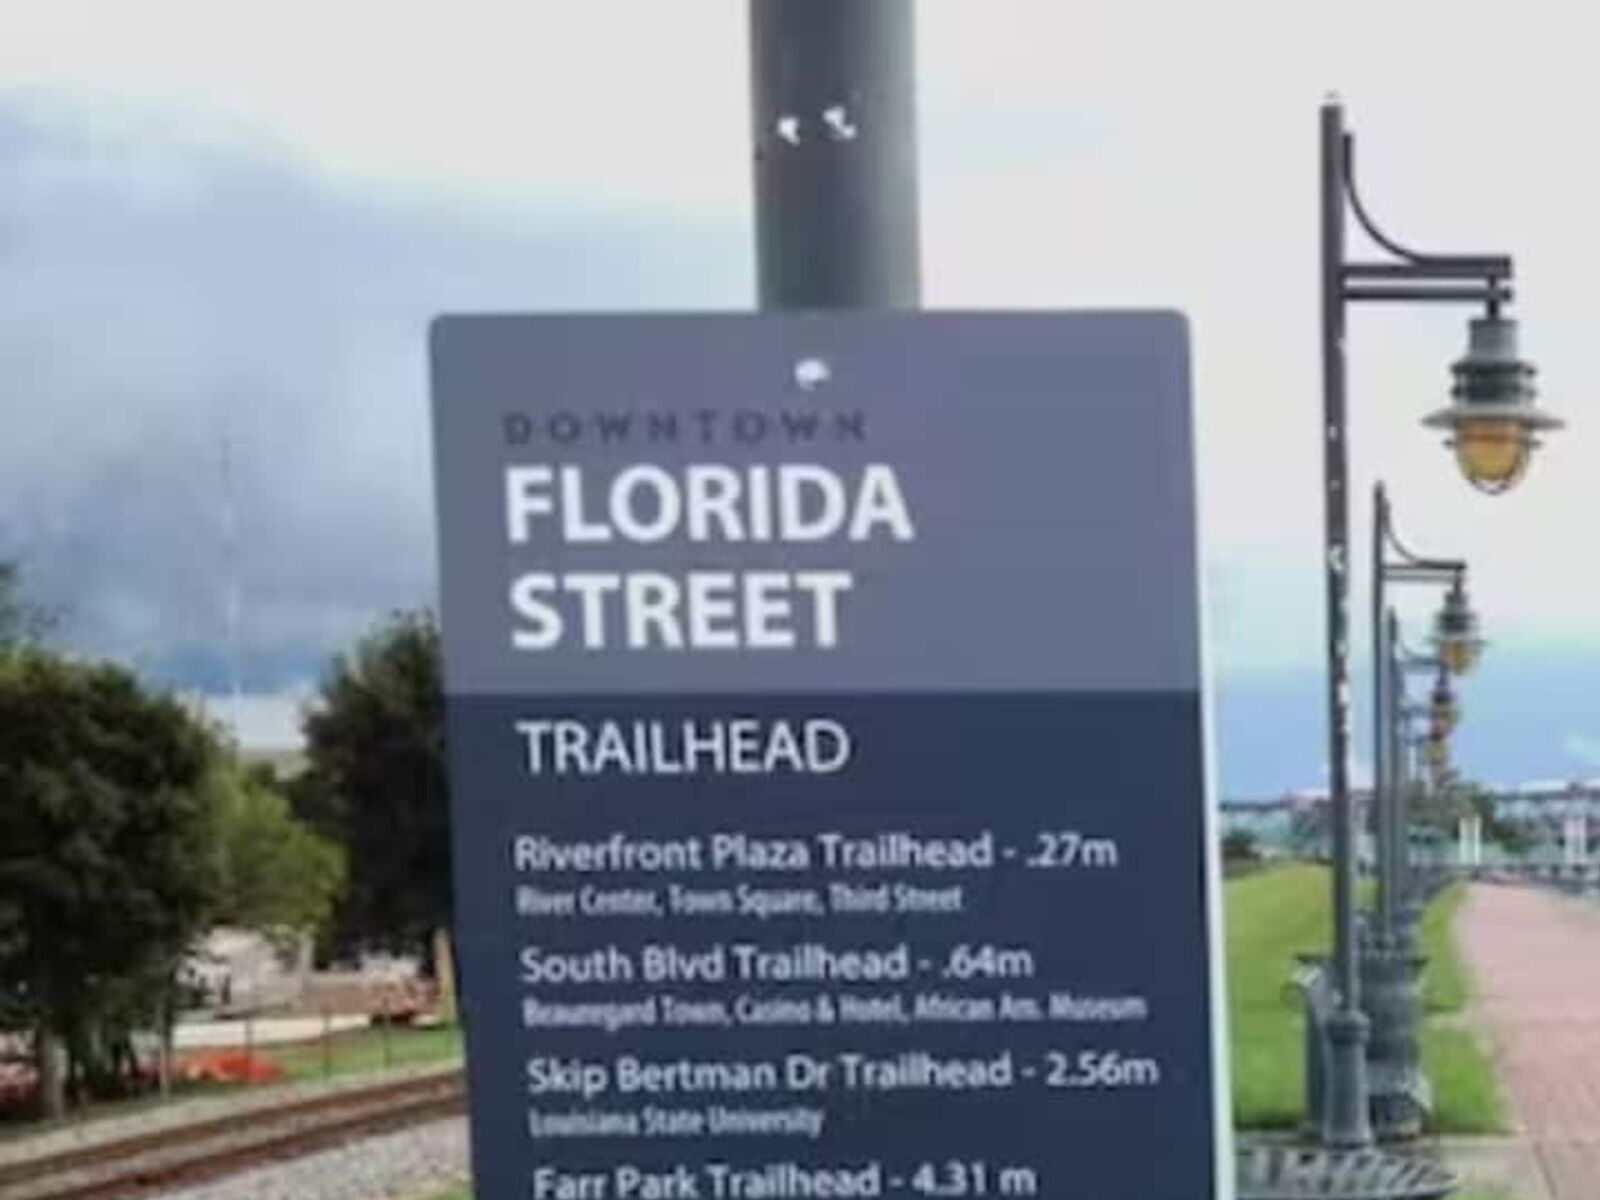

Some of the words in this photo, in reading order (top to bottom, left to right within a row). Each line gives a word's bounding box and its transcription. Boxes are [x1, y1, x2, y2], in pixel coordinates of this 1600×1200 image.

[503, 410, 868, 446] DOWNTOWN
[505, 464, 914, 543] FLORIDA
[510, 571, 852, 650] STREET
[516, 720, 849, 776] TRAILHEAD
[515, 831, 702, 872] Riverfront
[712, 834, 810, 871] Plaza
[817, 831, 994, 868] Trailhead
[1026, 832, 1118, 868] .27m
[516, 885, 576, 916] River
[668, 884, 734, 915] Town
[829, 884, 890, 912] Third
[894, 884, 963, 912] Street
[520, 944, 633, 983] South
[643, 944, 726, 982] Blvd
[733, 943, 909, 981] Trailhead
[942, 945, 1034, 979] .64m
[735, 994, 811, 1025] Casino
[527, 1058, 608, 1099] Skip
[616, 1056, 777, 1091] Bertman
[786, 1054, 832, 1091] Dr
[838, 1053, 1013, 1089] Trailhead
[1046, 1051, 1160, 1088] 2.56m
[529, 1109, 640, 1137] Louisiana
[642, 1106, 705, 1135] State
[707, 1105, 825, 1139] University
[533, 1168, 607, 1200] Farr
[615, 1164, 699, 1200] Park
[706, 1162, 881, 1198] Trailhead
[911, 1162, 986, 1197] 4.31
[999, 1168, 1037, 1195] m
